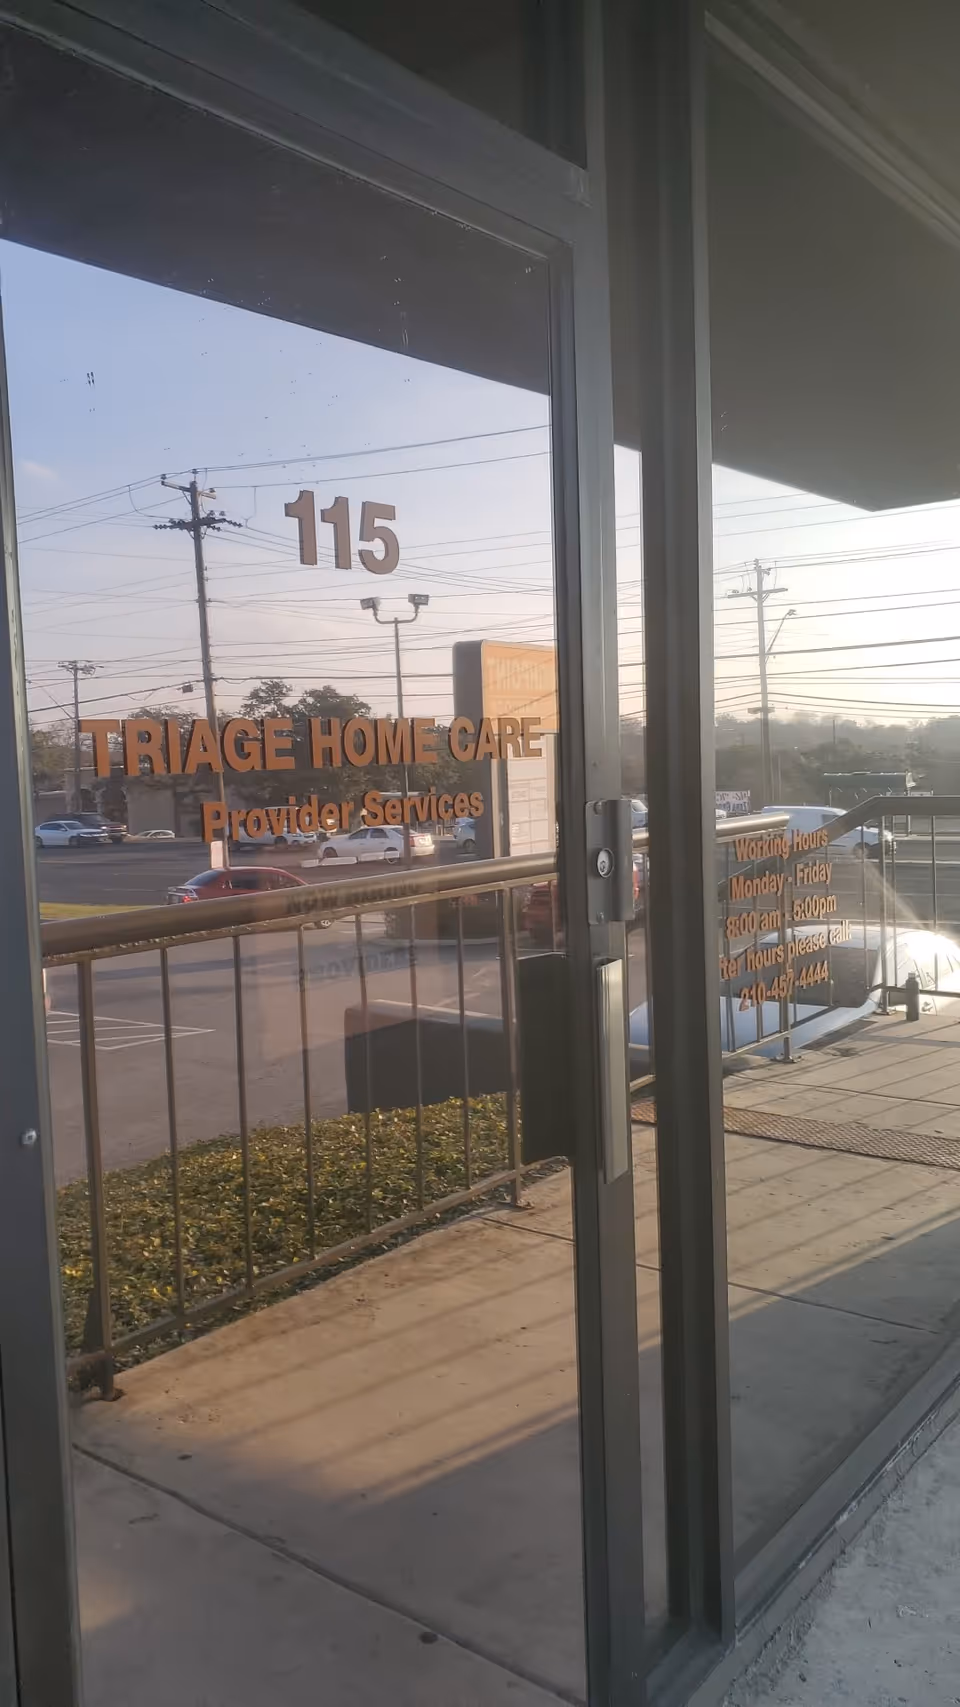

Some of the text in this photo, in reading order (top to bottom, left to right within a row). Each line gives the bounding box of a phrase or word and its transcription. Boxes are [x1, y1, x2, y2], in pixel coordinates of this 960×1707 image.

[284, 489, 400, 575] 115
[79, 716, 542, 777] TRIAGE HOME CARE
[202, 794, 354, 842] Provider
[361, 786, 484, 827] Services
[734, 829, 828, 862] Working Hours
[730, 871, 784, 901] Monday
[795, 860, 832, 886] Friday
[726, 911, 757, 939] 8:00
[759, 910, 782, 931] am
[792, 895, 837, 921] 5:00pm
[745, 944, 784, 972] hours
[786, 931, 826, 962] please
[739, 960, 829, 1012] 210-457-4444
